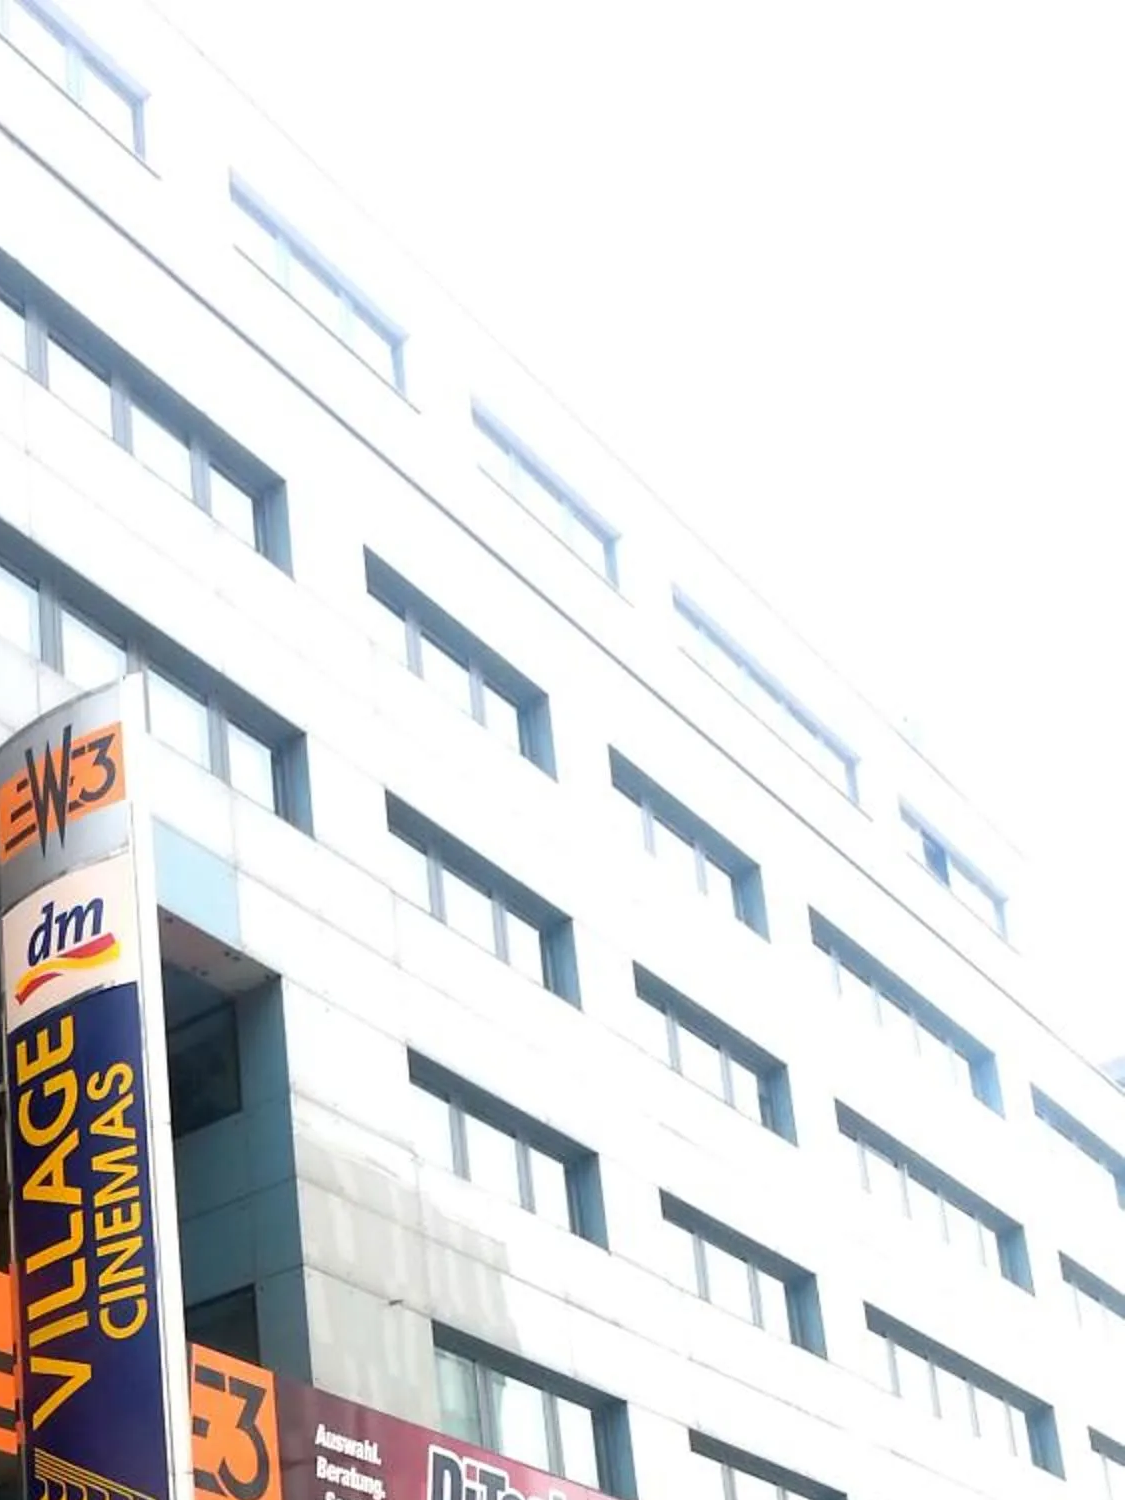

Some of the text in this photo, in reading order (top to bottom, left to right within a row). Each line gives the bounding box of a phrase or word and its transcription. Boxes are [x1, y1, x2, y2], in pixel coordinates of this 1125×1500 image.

[27, 897, 105, 967] dm
[16, 1015, 93, 1431] VILLAGE
[86, 1062, 148, 1339] CINEMAS
[315, 1423, 382, 1466] Auswahl.
